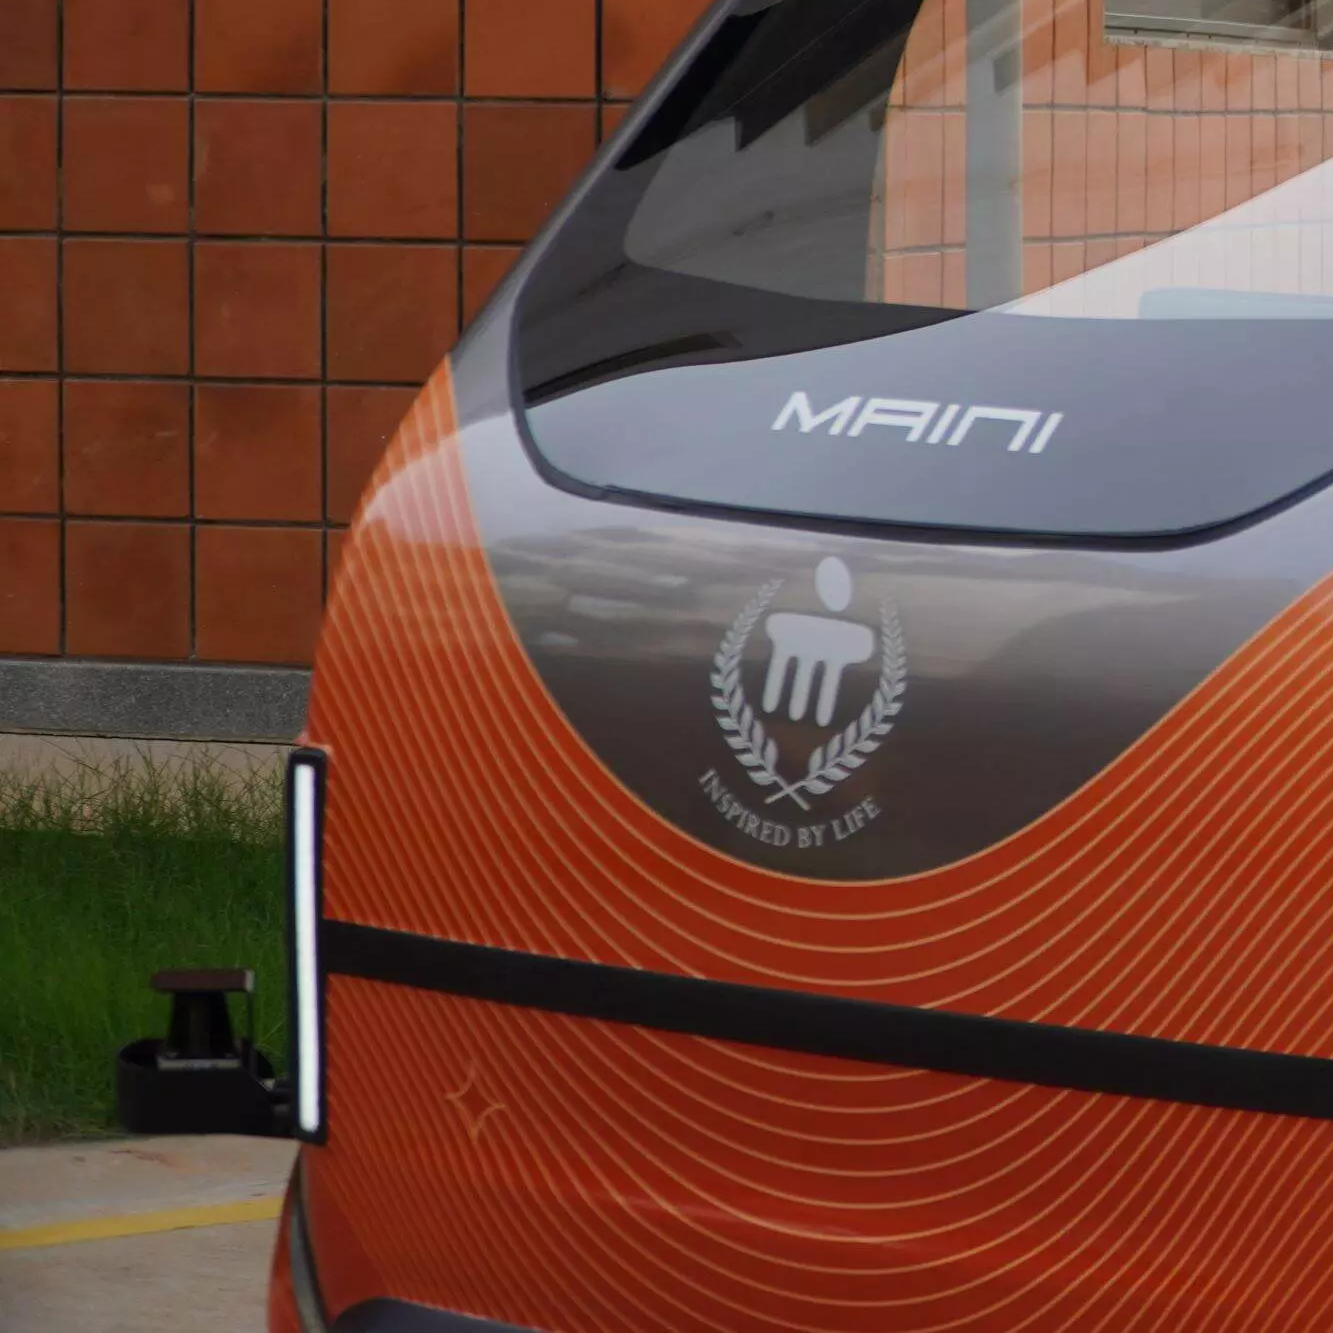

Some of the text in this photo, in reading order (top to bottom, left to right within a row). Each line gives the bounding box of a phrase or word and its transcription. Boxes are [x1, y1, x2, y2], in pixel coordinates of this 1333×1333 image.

[771, 391, 1065, 454] MAINI
[698, 768, 882, 849] INSPIRED BY LIFE
